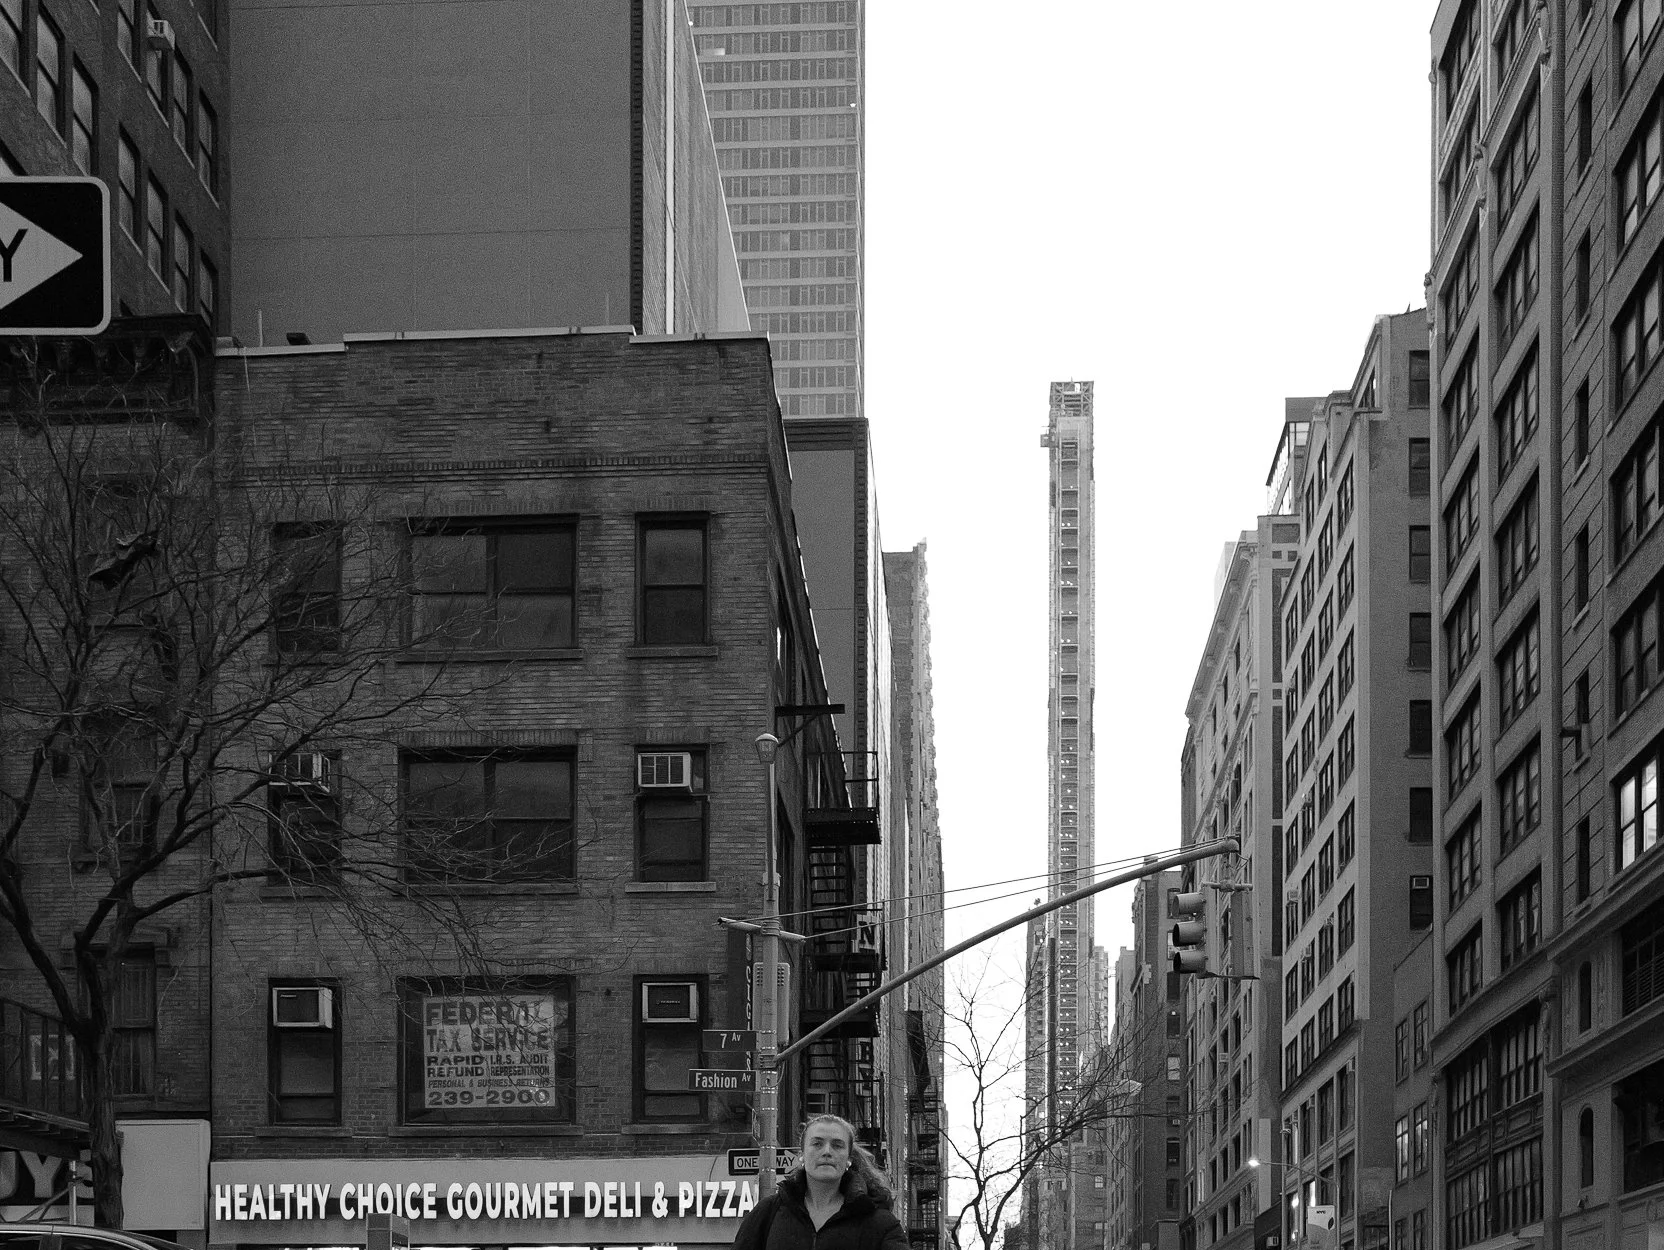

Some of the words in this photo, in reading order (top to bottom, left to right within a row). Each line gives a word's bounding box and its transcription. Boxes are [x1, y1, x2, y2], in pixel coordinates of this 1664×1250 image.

[427, 1027, 461, 1052] TAX
[471, 1026, 549, 1052] SERVICE
[720, 1033, 728, 1049] 7
[732, 1032, 741, 1042] Av
[427, 1055, 485, 1066] RAPID
[490, 1054, 514, 1065] I.R.S.
[520, 1053, 549, 1064] AUDIT
[427, 1066, 484, 1077] REFUND
[490, 1065, 549, 1077] REPRESENTATION
[428, 1080, 465, 1089] PERSONAL
[477, 1079, 513, 1088] BUSINESS
[695, 1072, 738, 1089] Fashion
[742, 1073, 751, 1082] Av
[428, 1089, 550, 1106] 239-2900
[737, 1157, 758, 1168] ONE
[215, 1183, 332, 1221] HEALTHY
[339, 1182, 437, 1220] CHOICE
[447, 1181, 574, 1220] GOURMET
[584, 1181, 642, 1218] DELI
[651, 1181, 669, 1218] &
